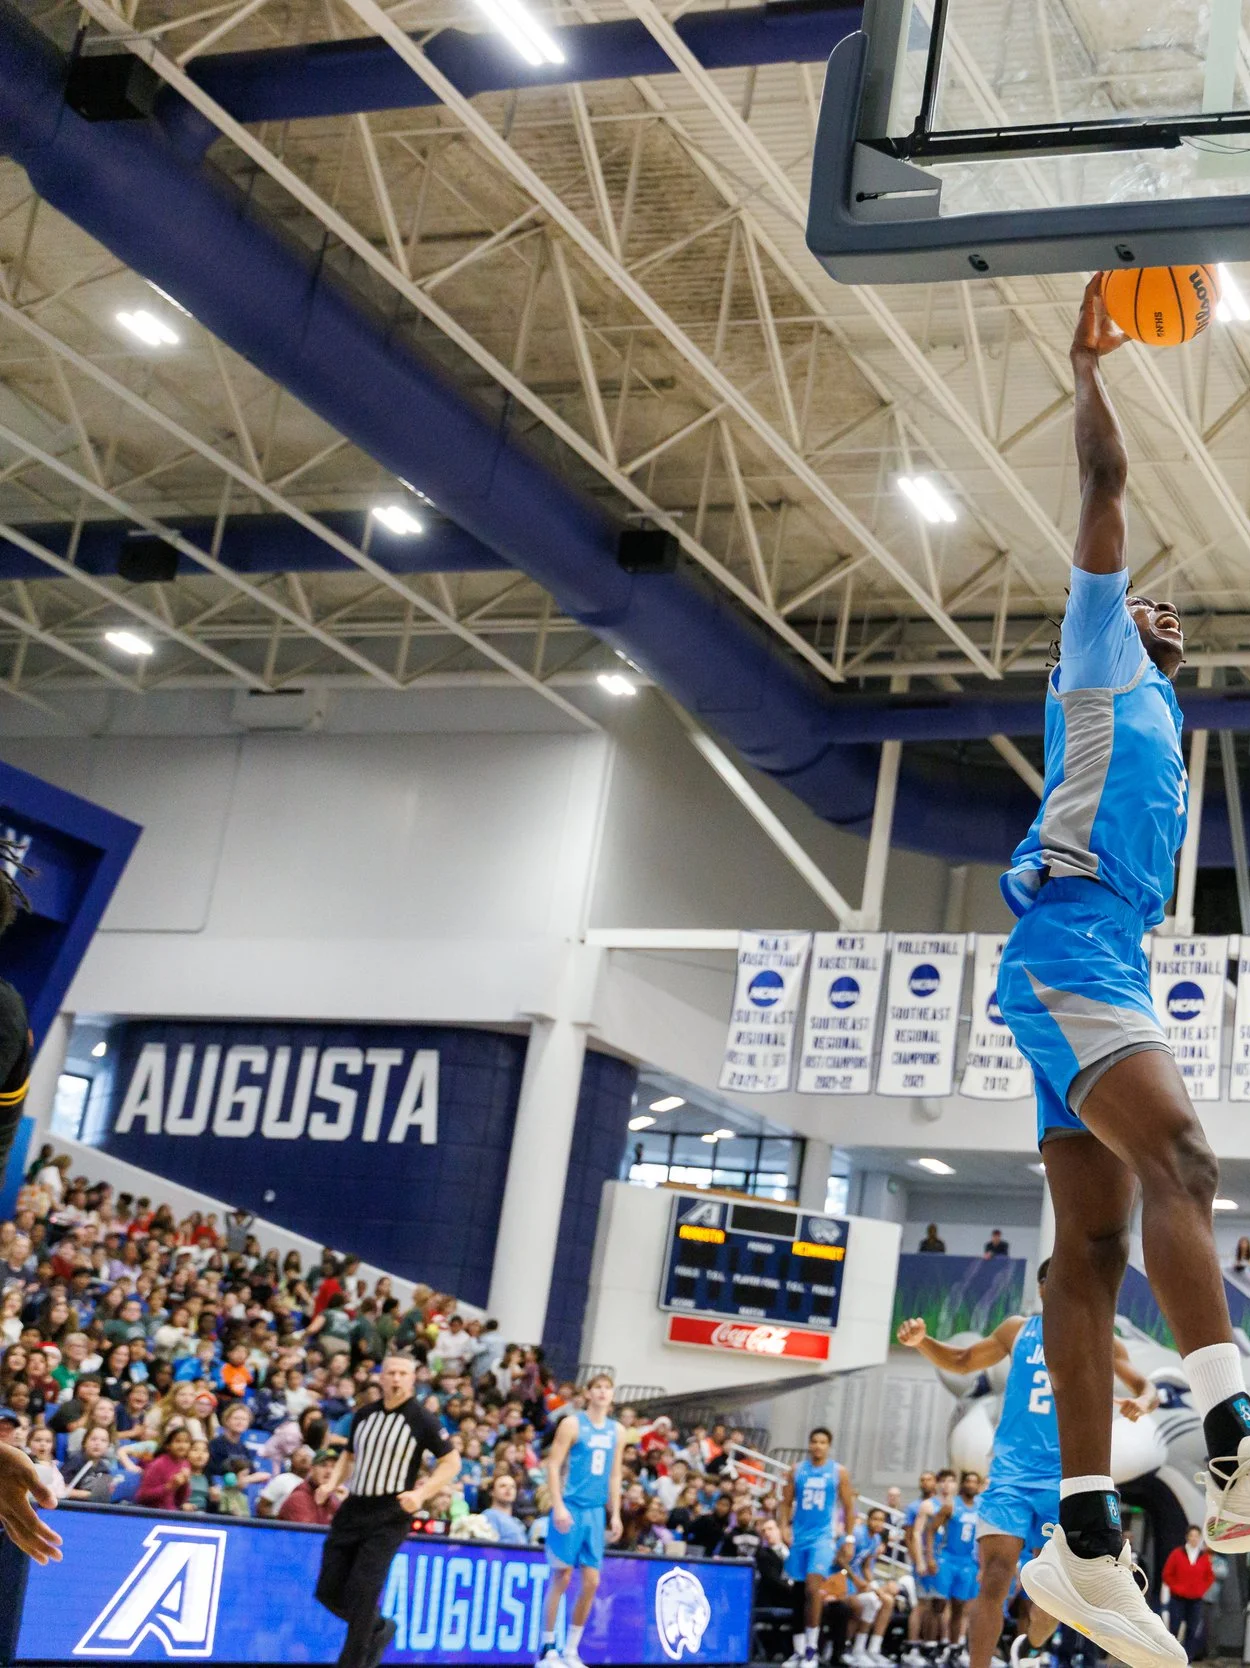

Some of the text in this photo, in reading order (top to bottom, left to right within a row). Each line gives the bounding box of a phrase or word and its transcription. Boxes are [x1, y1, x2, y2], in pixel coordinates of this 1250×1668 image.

[1154, 312, 1164, 332] NFHS
[1173, 943, 1207, 957] MEN'S
[1156, 960, 1221, 976] BASKETBALL
[1166, 1026, 1217, 1040] UTHEAST
[114, 1043, 439, 1144] AUGUSTA
[1026, 1343, 1046, 1365] JA
[1028, 1370, 1054, 1415] 2
[802, 1490, 826, 1510] 24
[72, 1525, 228, 1659] A
